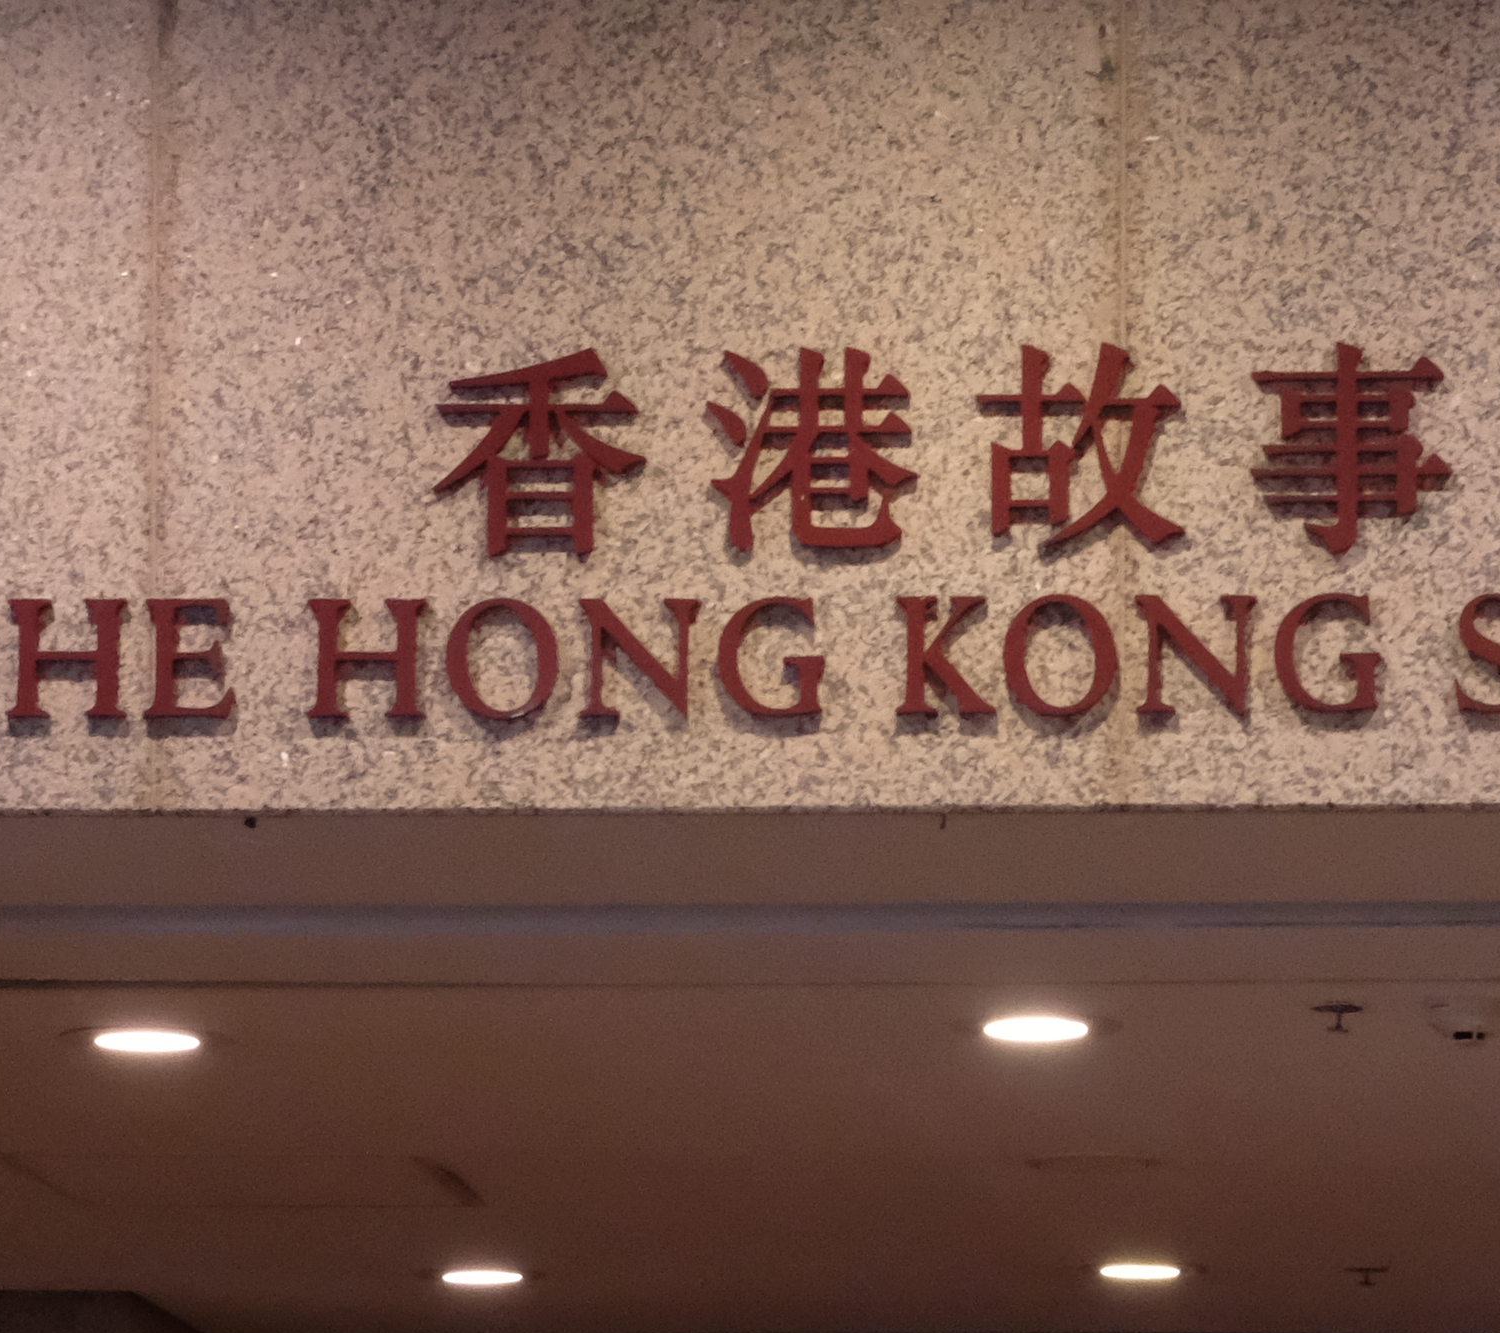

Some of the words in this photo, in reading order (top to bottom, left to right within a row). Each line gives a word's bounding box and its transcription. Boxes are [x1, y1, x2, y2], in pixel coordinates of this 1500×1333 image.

[433, 342, 1451, 556] 香港故事
[306, 598, 825, 721] HONG
[897, 593, 1381, 716] KONG
